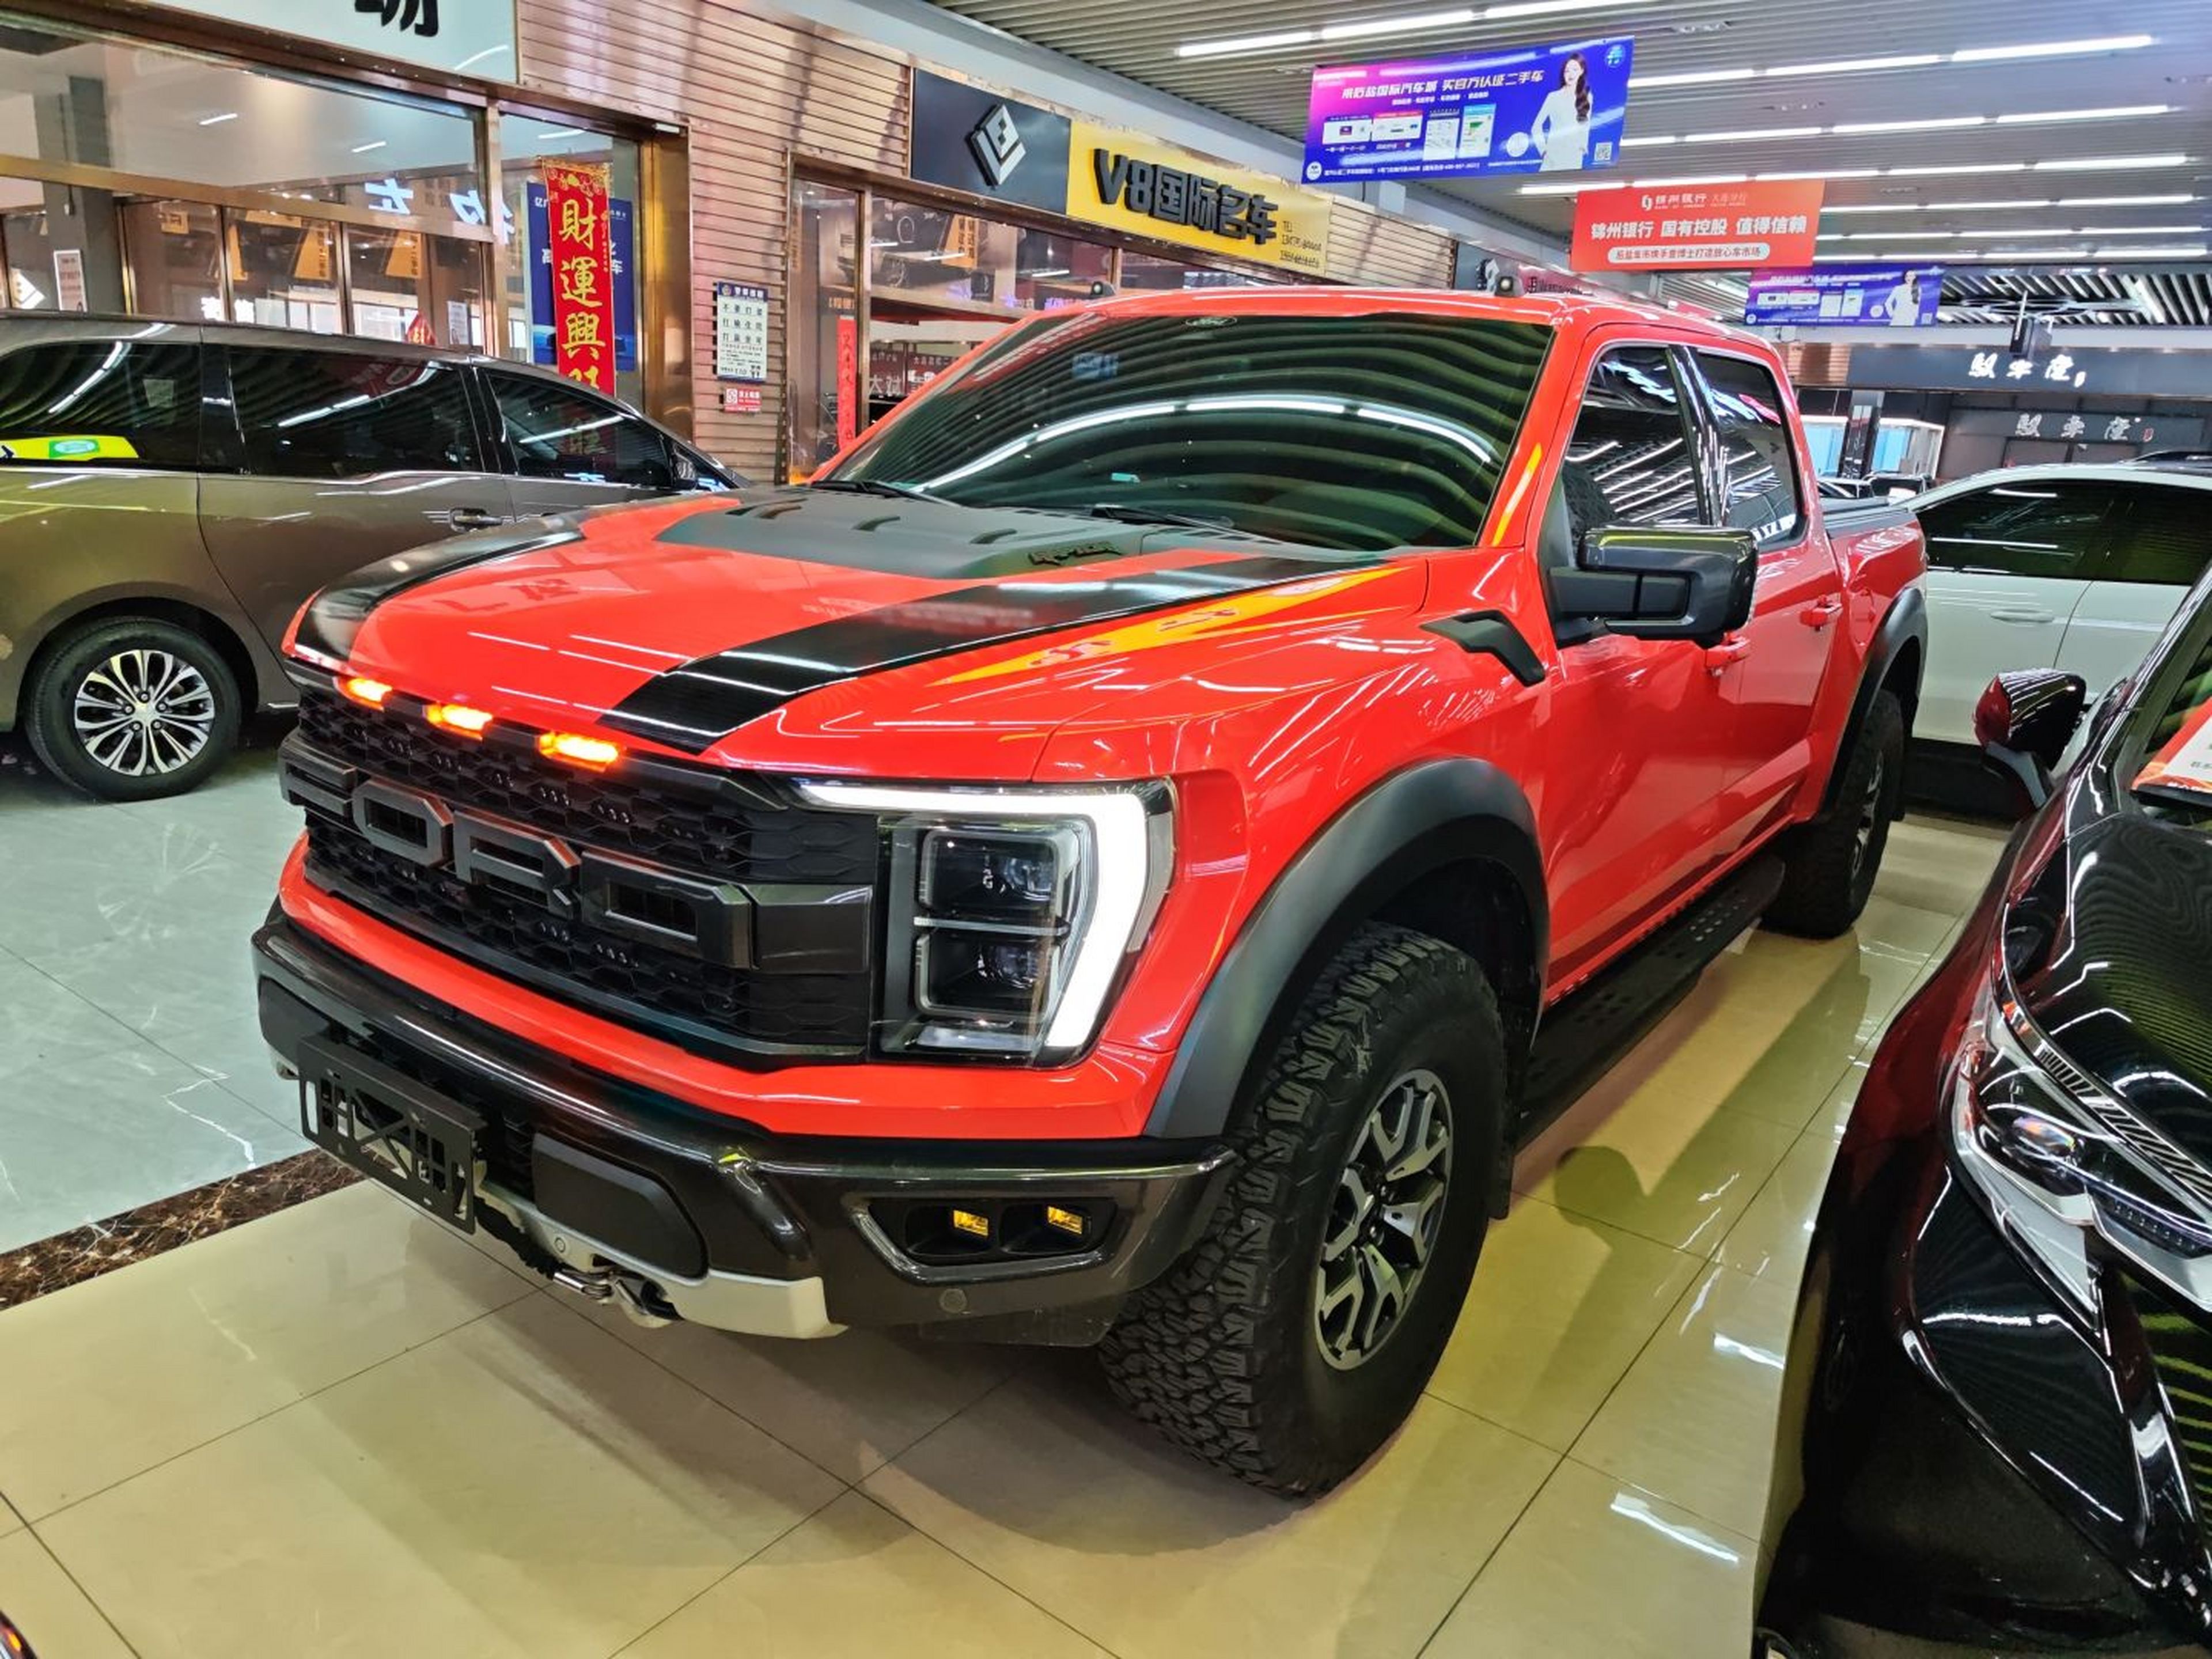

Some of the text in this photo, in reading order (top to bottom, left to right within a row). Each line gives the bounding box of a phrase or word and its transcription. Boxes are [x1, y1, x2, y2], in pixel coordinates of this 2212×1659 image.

[1093, 148, 1278, 246] V8国际名车
[1591, 221, 1653, 239] 锦州银行
[1661, 218, 1728, 237] 国有控股
[279, 743, 751, 969] FORD
